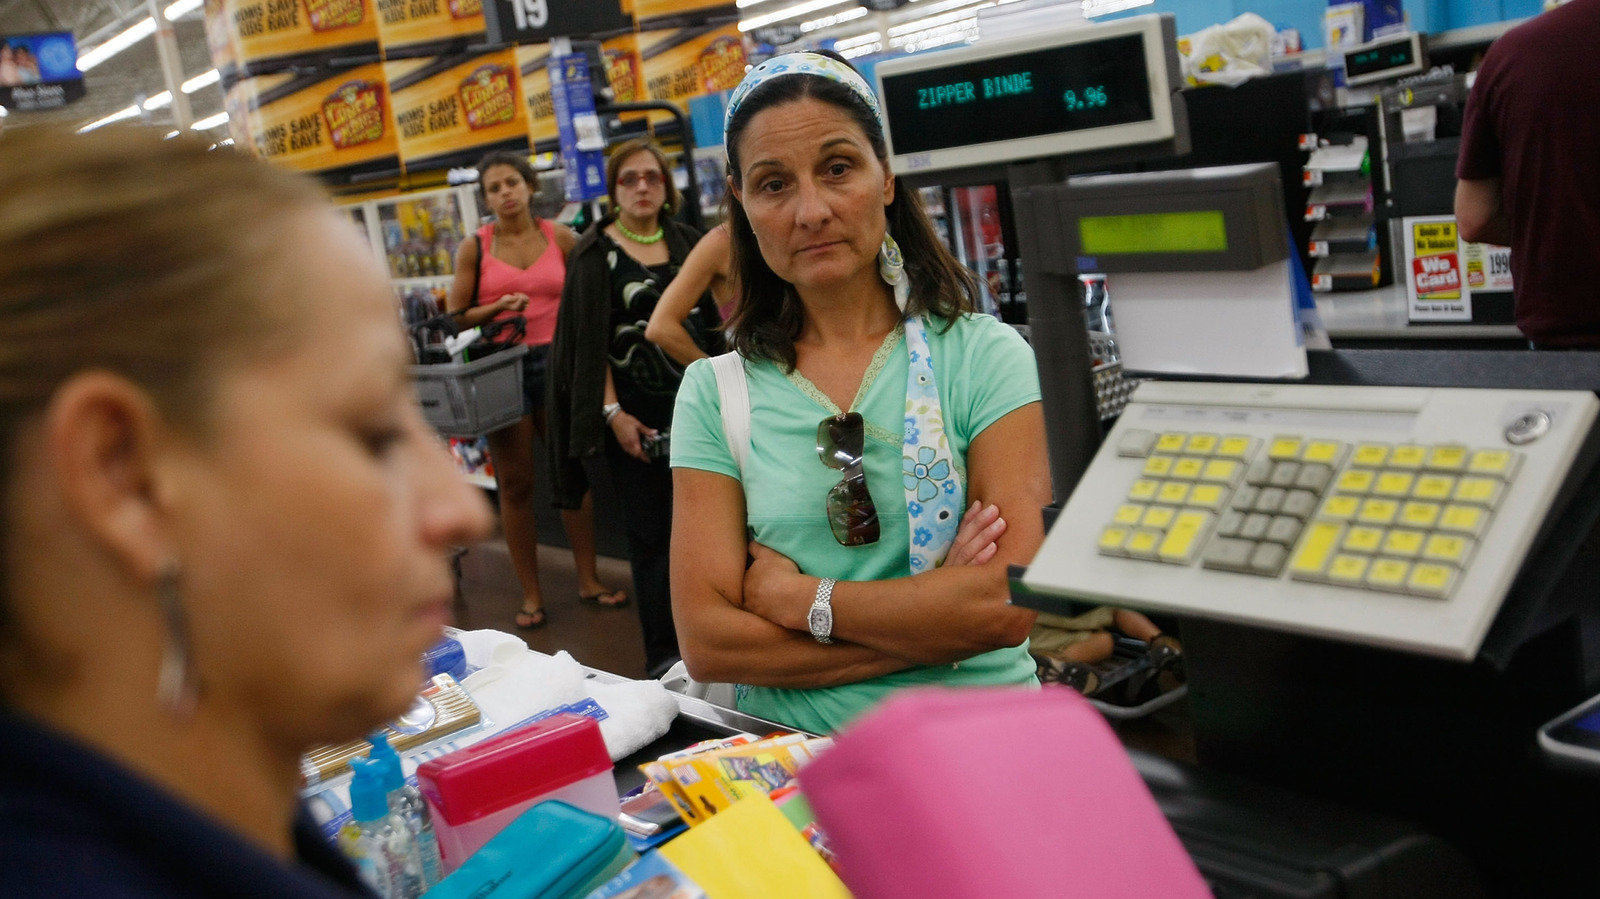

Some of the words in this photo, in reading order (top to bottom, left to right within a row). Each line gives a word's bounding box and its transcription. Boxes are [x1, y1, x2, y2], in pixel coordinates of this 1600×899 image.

[511, 0, 549, 30] 19
[917, 81, 976, 110] ZIPPER
[982, 71, 1034, 99] BINDE
[1063, 84, 1108, 112] 9.96
[397, 106, 425, 125] MOMS
[428, 95, 457, 116] SAVE
[429, 109, 458, 132] RAVE
[290, 113, 321, 134] SAVE
[291, 127, 322, 150] RAVE
[1422, 257, 1451, 272] We
[1416, 269, 1459, 288] Card
